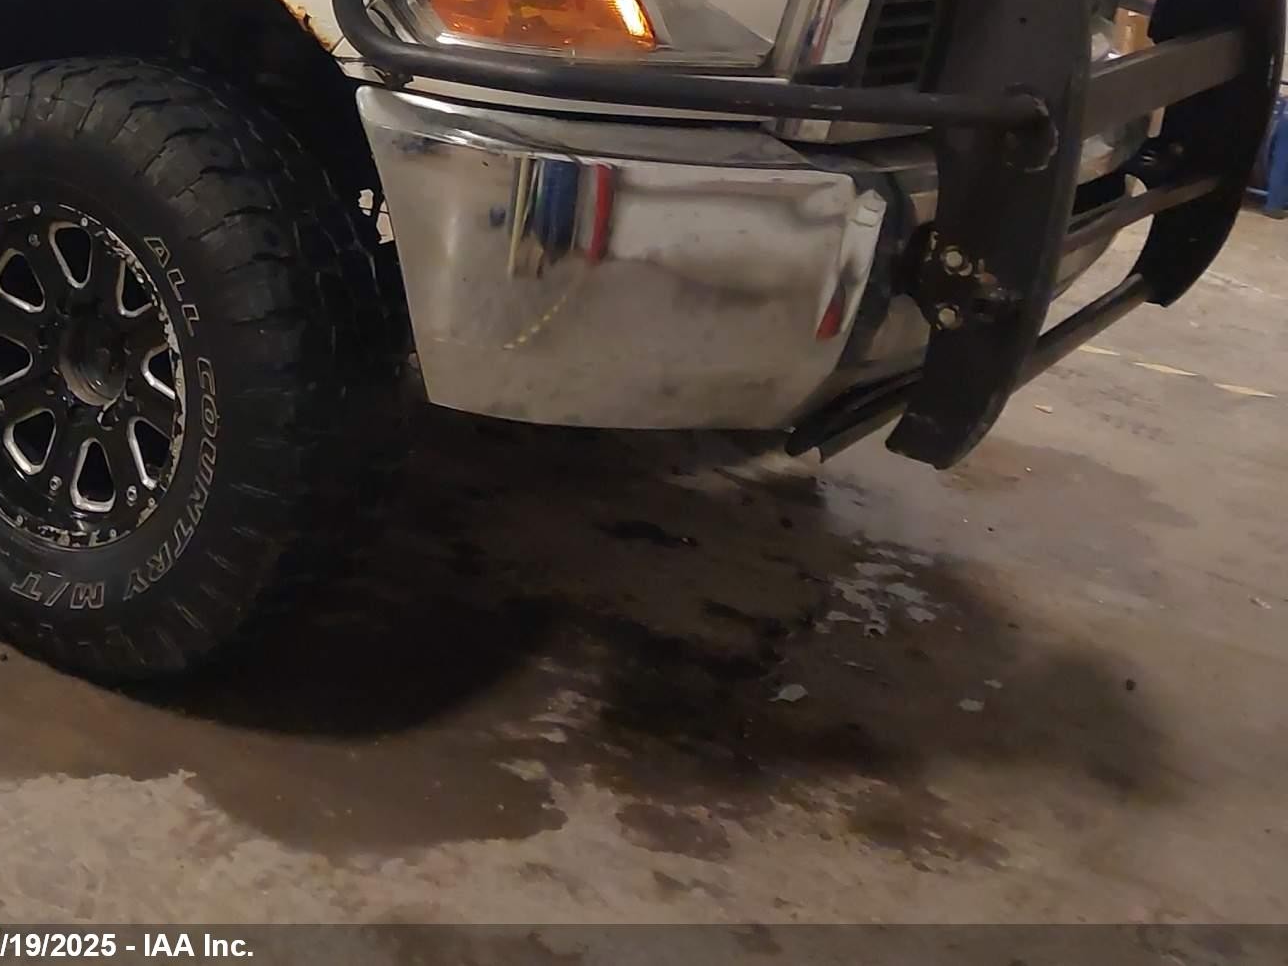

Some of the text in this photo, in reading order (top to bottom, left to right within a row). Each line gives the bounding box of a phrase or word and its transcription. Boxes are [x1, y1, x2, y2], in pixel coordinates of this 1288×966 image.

[10, 236, 217, 609] ALL COUNTRY M/T
